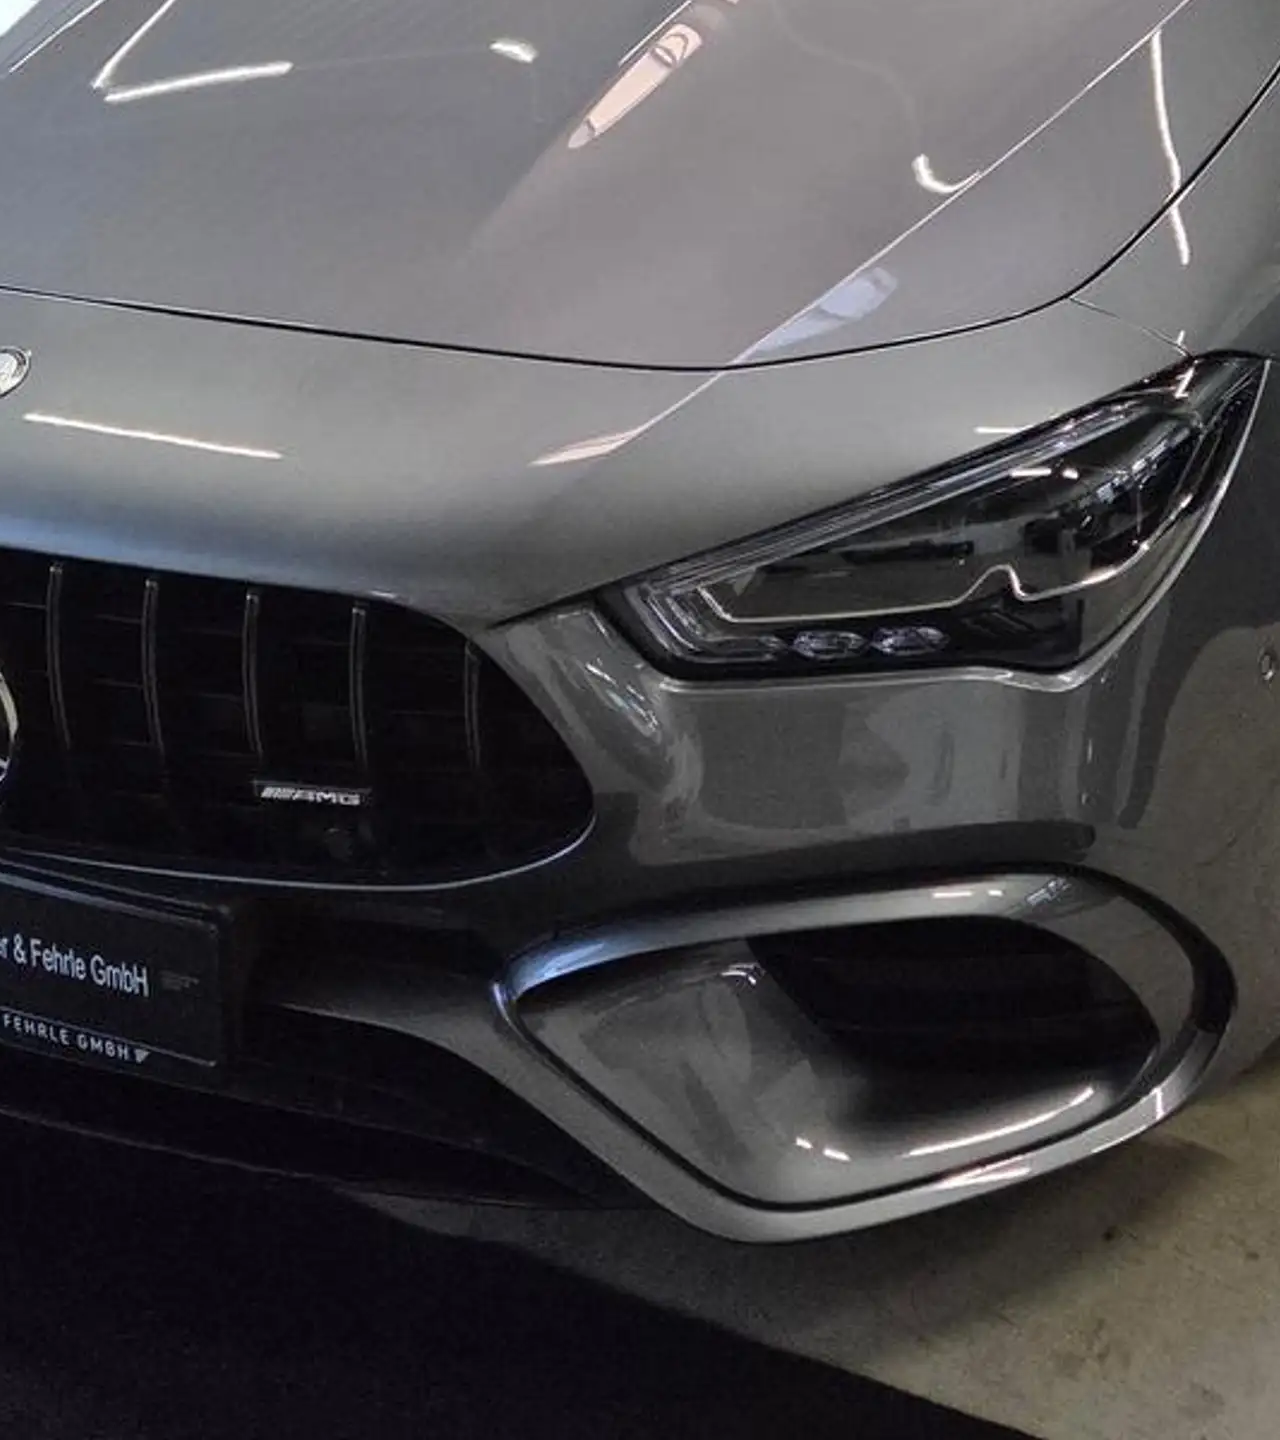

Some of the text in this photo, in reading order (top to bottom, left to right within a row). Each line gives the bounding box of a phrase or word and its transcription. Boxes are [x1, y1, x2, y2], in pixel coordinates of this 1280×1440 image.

[13, 933, 28, 965] &
[30, 937, 87, 981] Fehrle
[90, 954, 150, 998] GmbH
[3, 1013, 70, 1046] FEHRLE
[76, 1034, 130, 1062] GMBH
